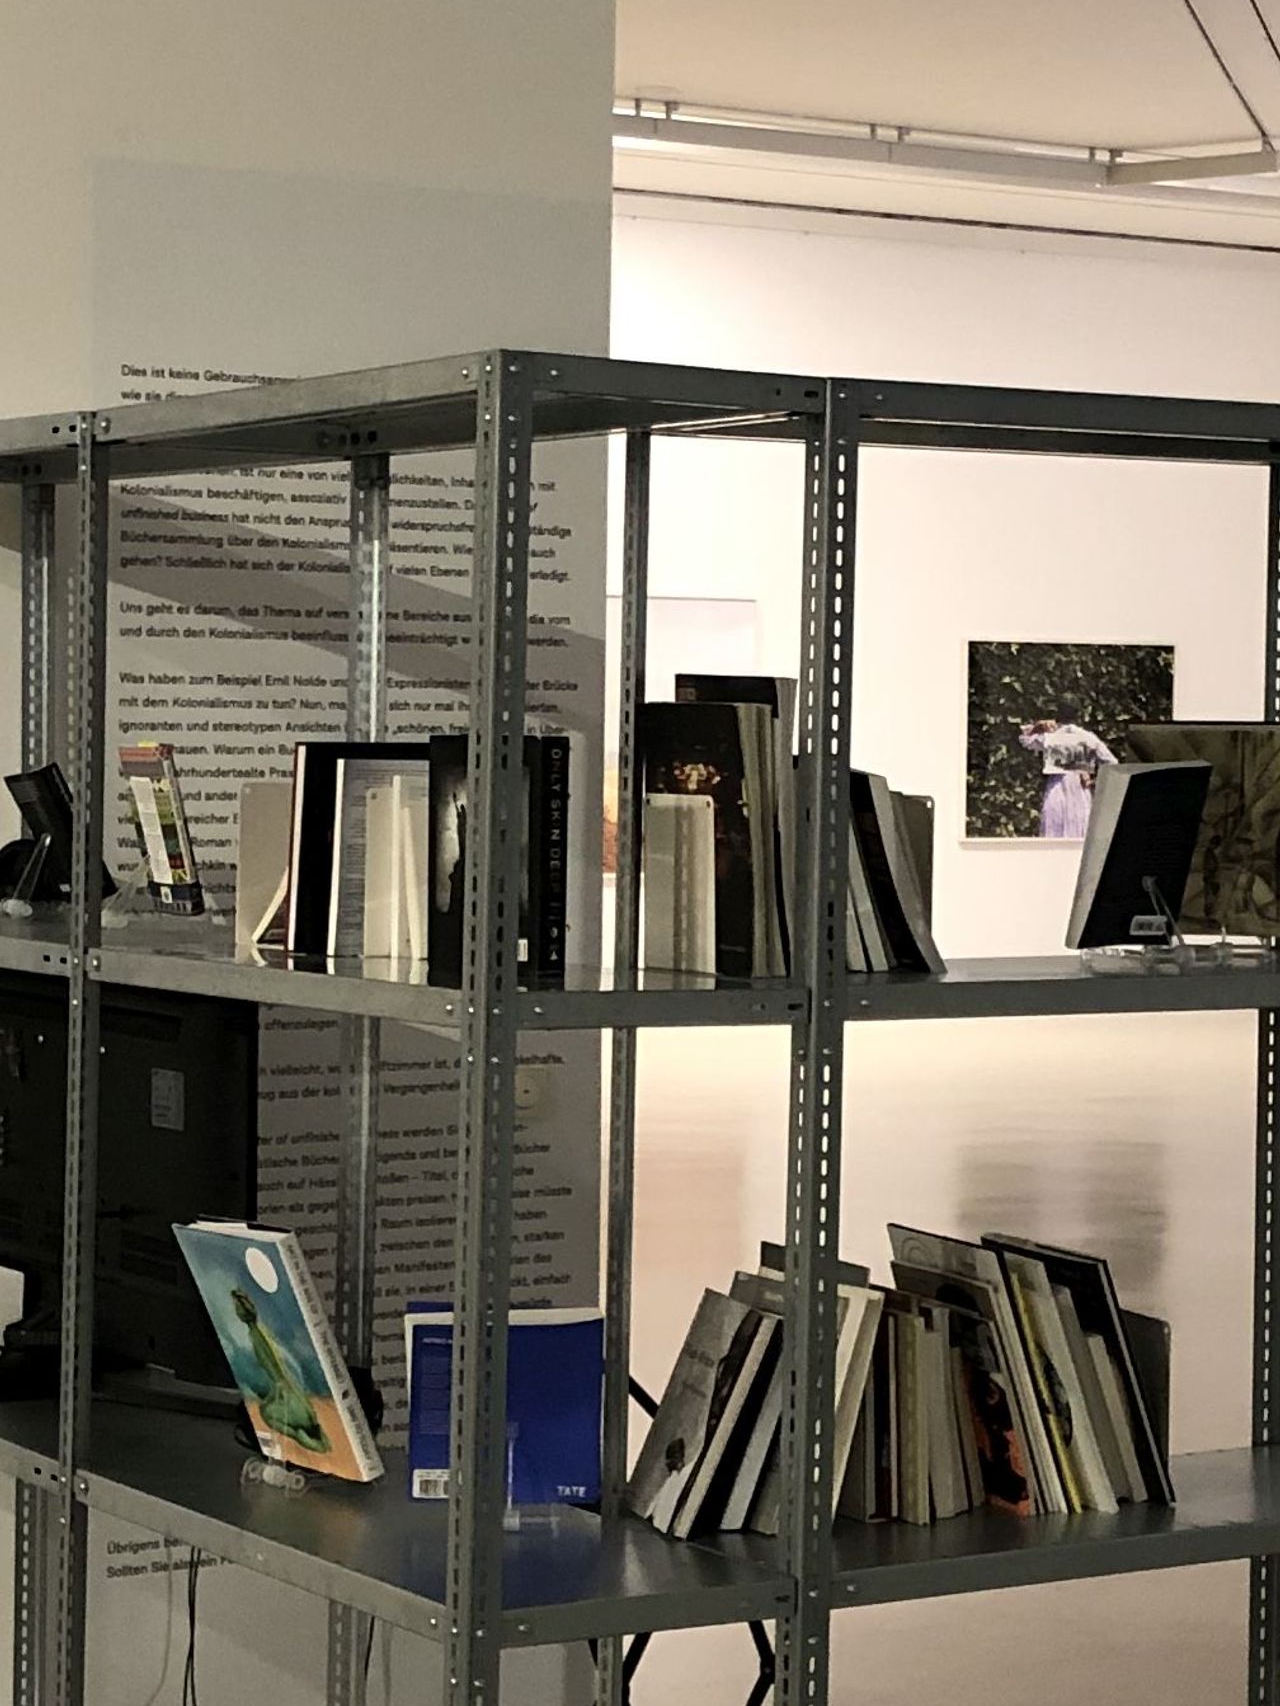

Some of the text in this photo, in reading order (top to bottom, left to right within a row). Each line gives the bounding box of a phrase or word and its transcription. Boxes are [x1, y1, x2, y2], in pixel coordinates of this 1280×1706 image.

[120, 363, 201, 380] Dies ist keine
[120, 388, 162, 401] wie sie
[257, 469, 277, 478] nur
[279, 468, 305, 479] eine
[306, 471, 328, 480] von
[537, 481, 557, 491] mit
[120, 483, 346, 505] Kolonialismus beschäftigen, assoziativ
[180, 508, 229, 522] business
[231, 512, 250, 523] hat
[252, 512, 281, 525] nicht
[283, 514, 306, 526] den
[226, 534, 253, 547] über
[256, 535, 279, 548] den
[229, 558, 249, 570] hat
[251, 559, 273, 570] sich
[276, 560, 295, 571] der
[394, 564, 428, 576] vielen
[428, 565, 470, 577] Ebenen
[119, 601, 143, 613] Uns
[145, 602, 174, 617] geht
[176, 606, 189, 614] es
[237, 605, 259, 617] das
[262, 604, 301, 617] Thema
[304, 606, 323, 618] auf
[547, 615, 571, 625] vom
[118, 625, 142, 637] und
[144, 625, 180, 637] durch
[182, 626, 206, 638] den
[207, 627, 291, 640] Kolonialismus
[118, 672, 579, 691] Was haben zum Beispiel Emil Nolde Brücke
[117, 695, 455, 711] mit dem Kolonialismus zu tun? Nun, sich nur mal
[117, 719, 183, 733] ignoranten
[185, 720, 209, 731] und
[211, 721, 282, 734] stereotypen
[284, 721, 341, 732] Ansichten
[557, 1485, 587, 1498] TATE
[105, 1537, 161, 1556] Übrigens
[105, 1560, 169, 1578] Sollten Sie
